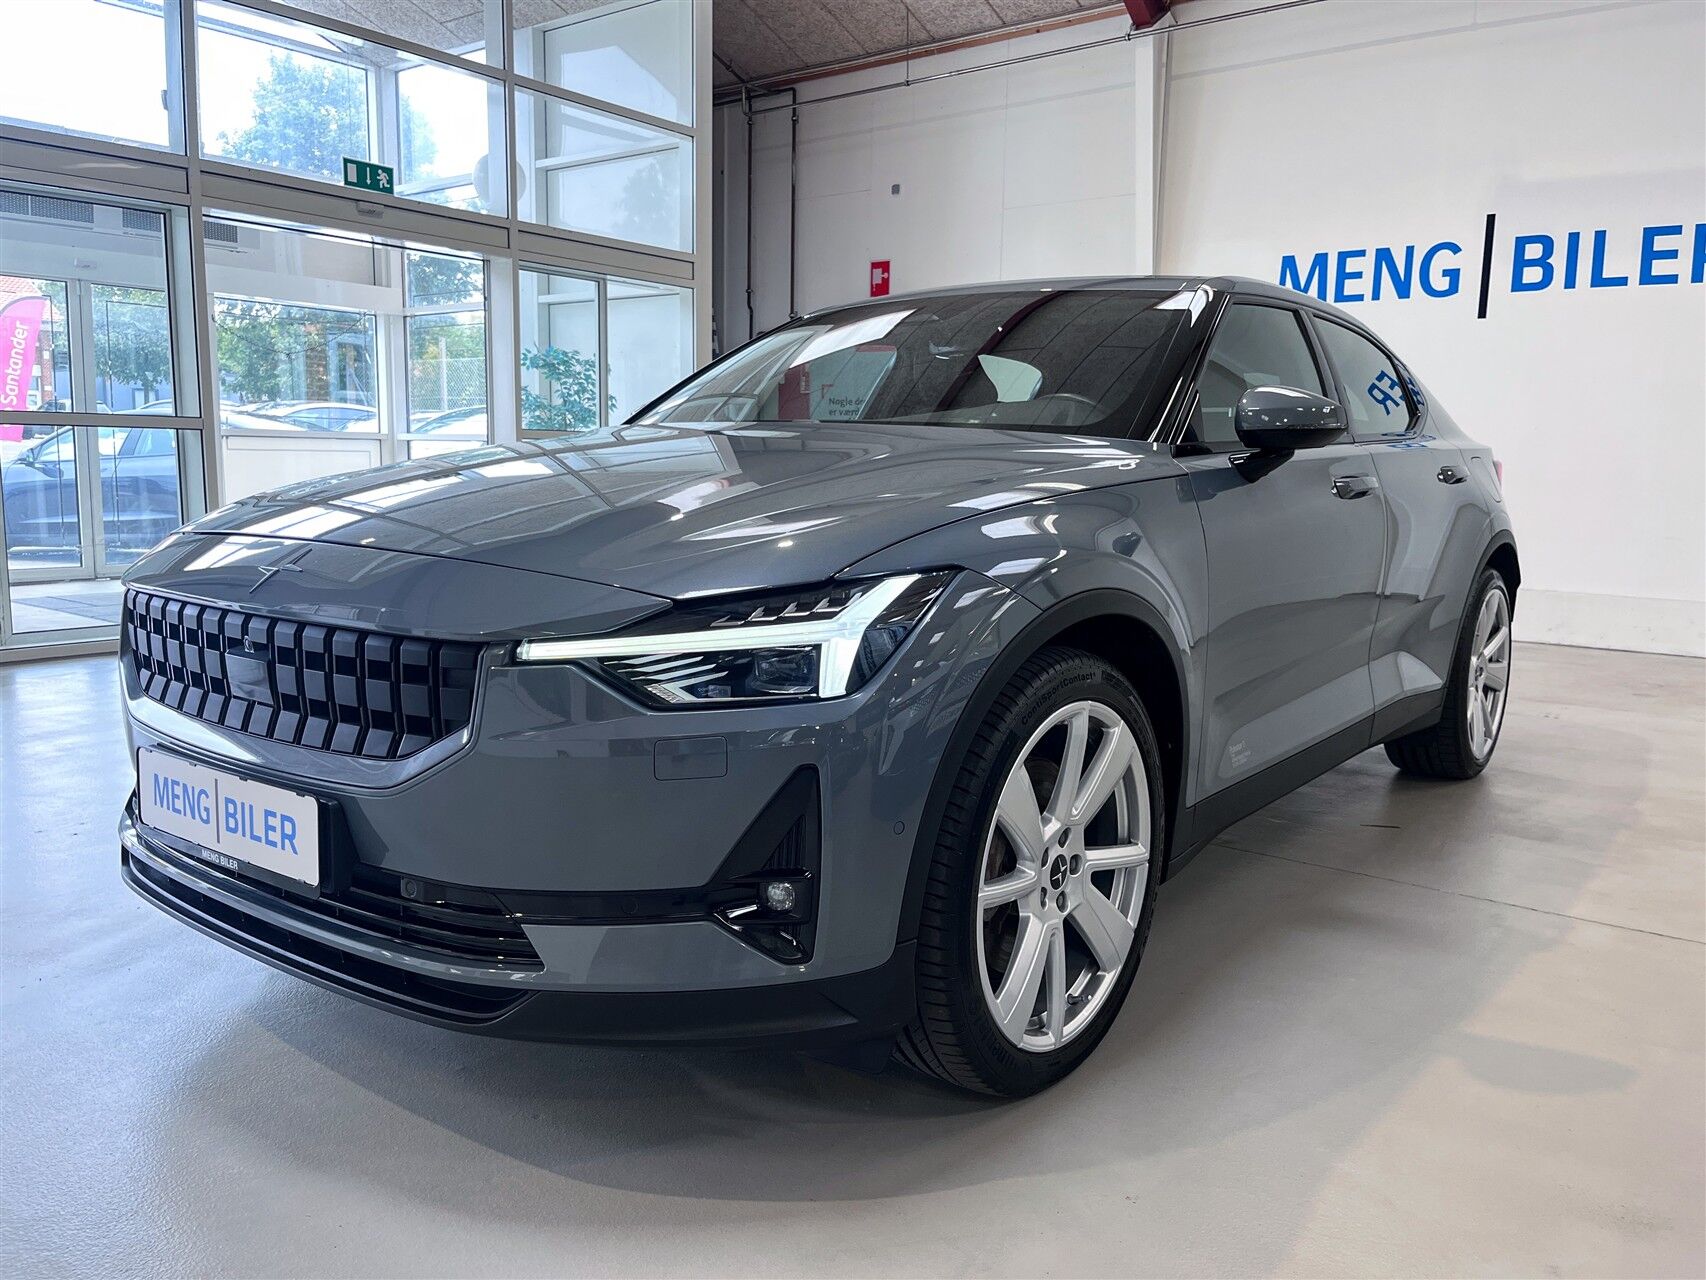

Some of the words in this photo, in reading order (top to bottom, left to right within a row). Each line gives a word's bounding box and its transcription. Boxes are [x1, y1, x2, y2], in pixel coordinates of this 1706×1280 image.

[1278, 241, 1463, 303] MENG
[1, 320, 30, 406] Santander
[828, 395, 853, 408] Nogle
[153, 773, 211, 825] MENG
[224, 796, 299, 856] BILER
[201, 849, 220, 864] MENG
[220, 857, 239, 870] BILER
